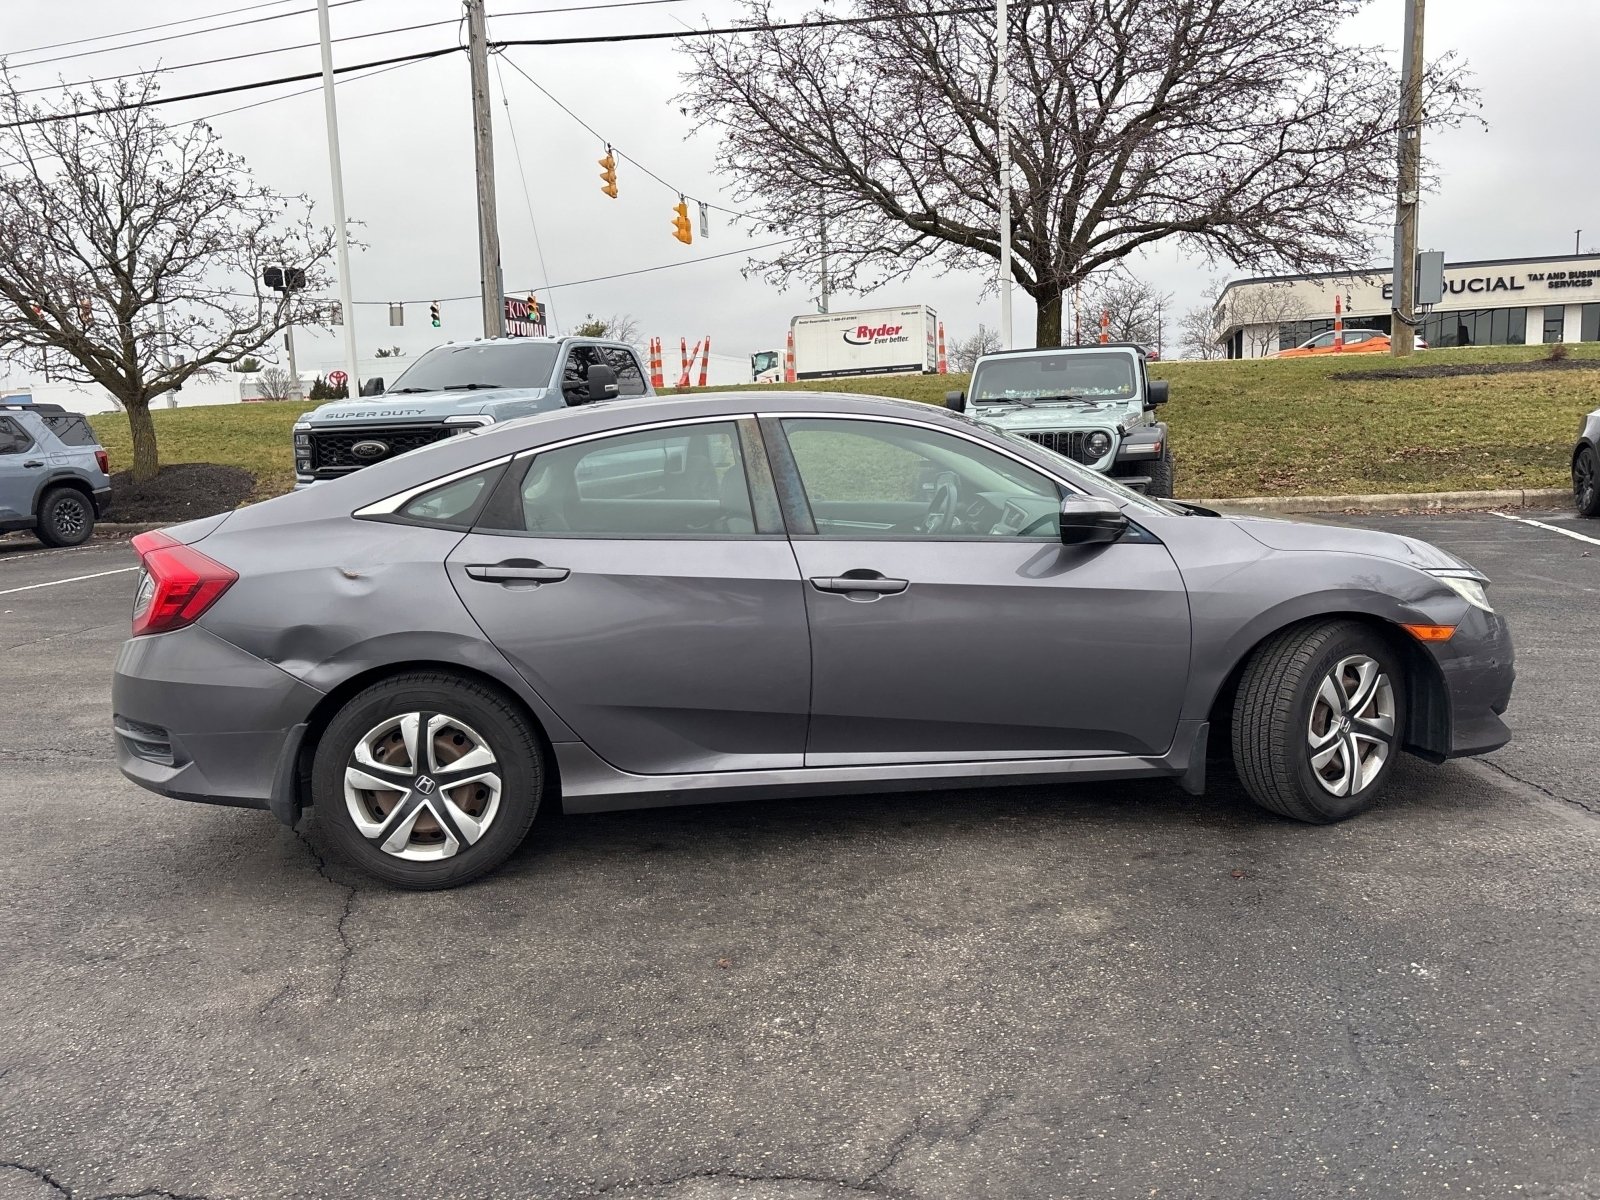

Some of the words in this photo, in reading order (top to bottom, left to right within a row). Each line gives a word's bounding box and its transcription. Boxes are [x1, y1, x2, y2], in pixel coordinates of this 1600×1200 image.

[1528, 272, 1545, 281] TAX
[1546, 271, 1567, 281] AND
[1547, 278, 1593, 289] SERVICES
[856, 323, 903, 340] Ryder
[874, 336, 889, 345] Ever
[325, 411, 377, 419] SUPER
[380, 409, 426, 417] DUTY
